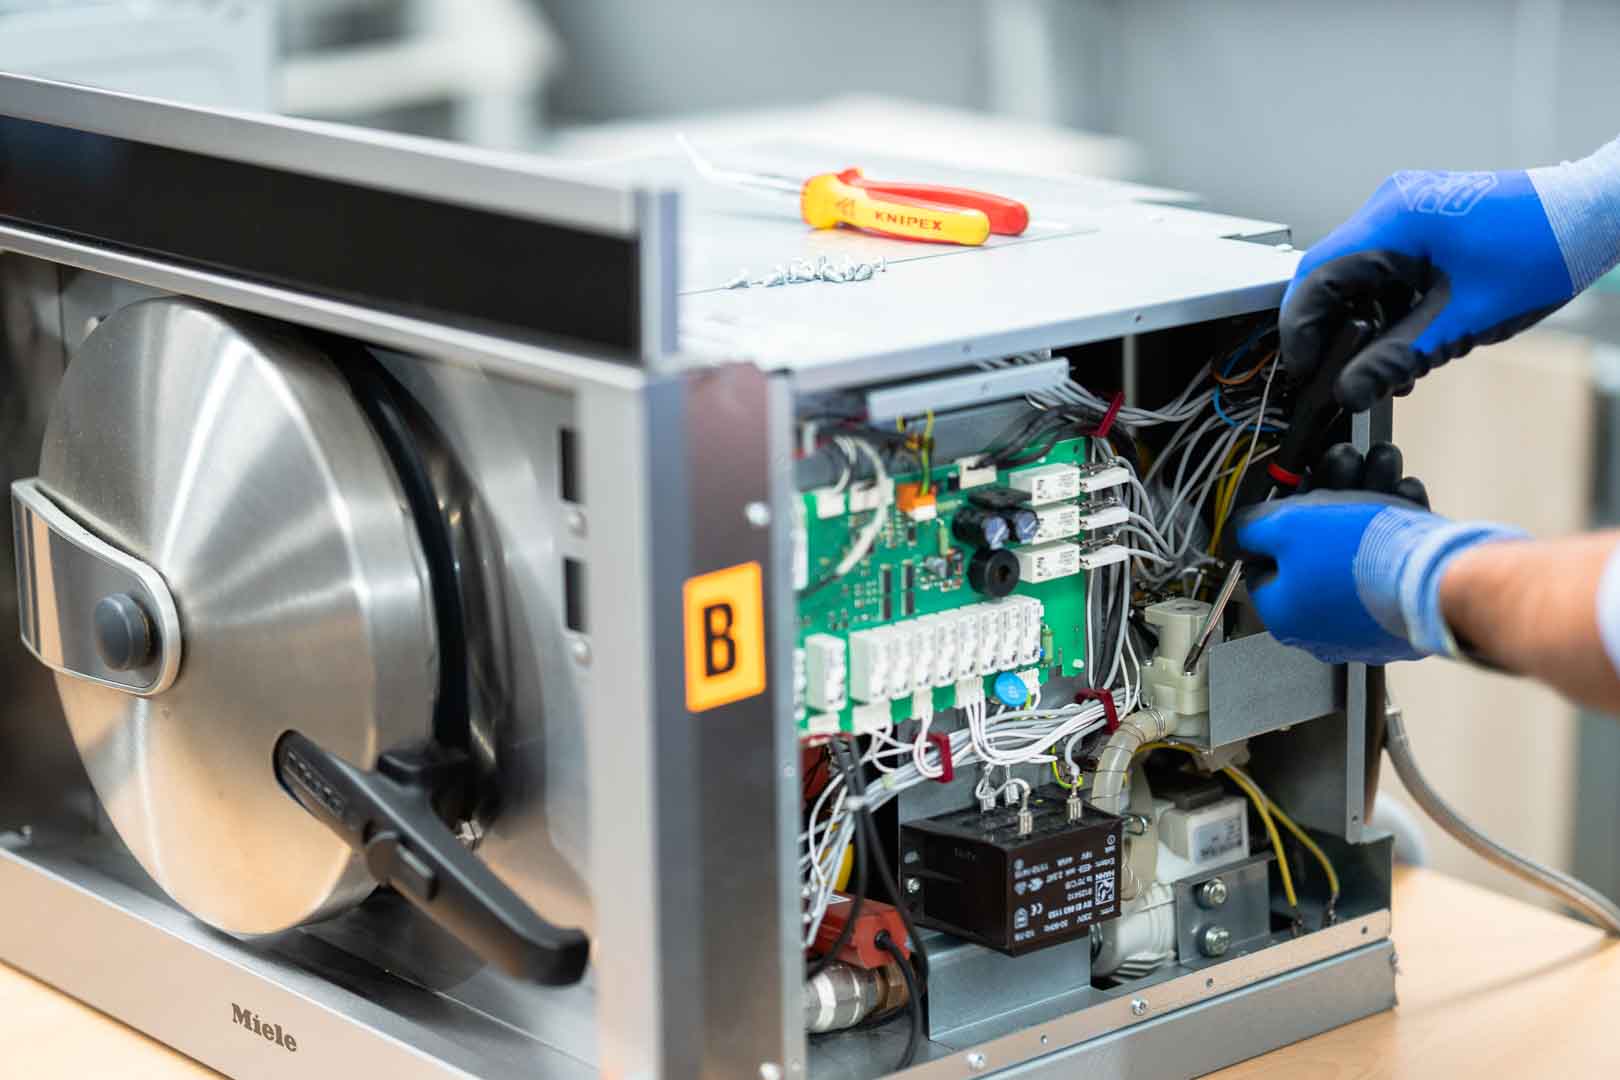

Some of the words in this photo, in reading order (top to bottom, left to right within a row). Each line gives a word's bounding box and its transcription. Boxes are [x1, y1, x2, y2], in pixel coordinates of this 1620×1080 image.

[875, 211, 943, 231] KNIPEX
[704, 603, 737, 678] B
[231, 1002, 297, 1052] Miele
